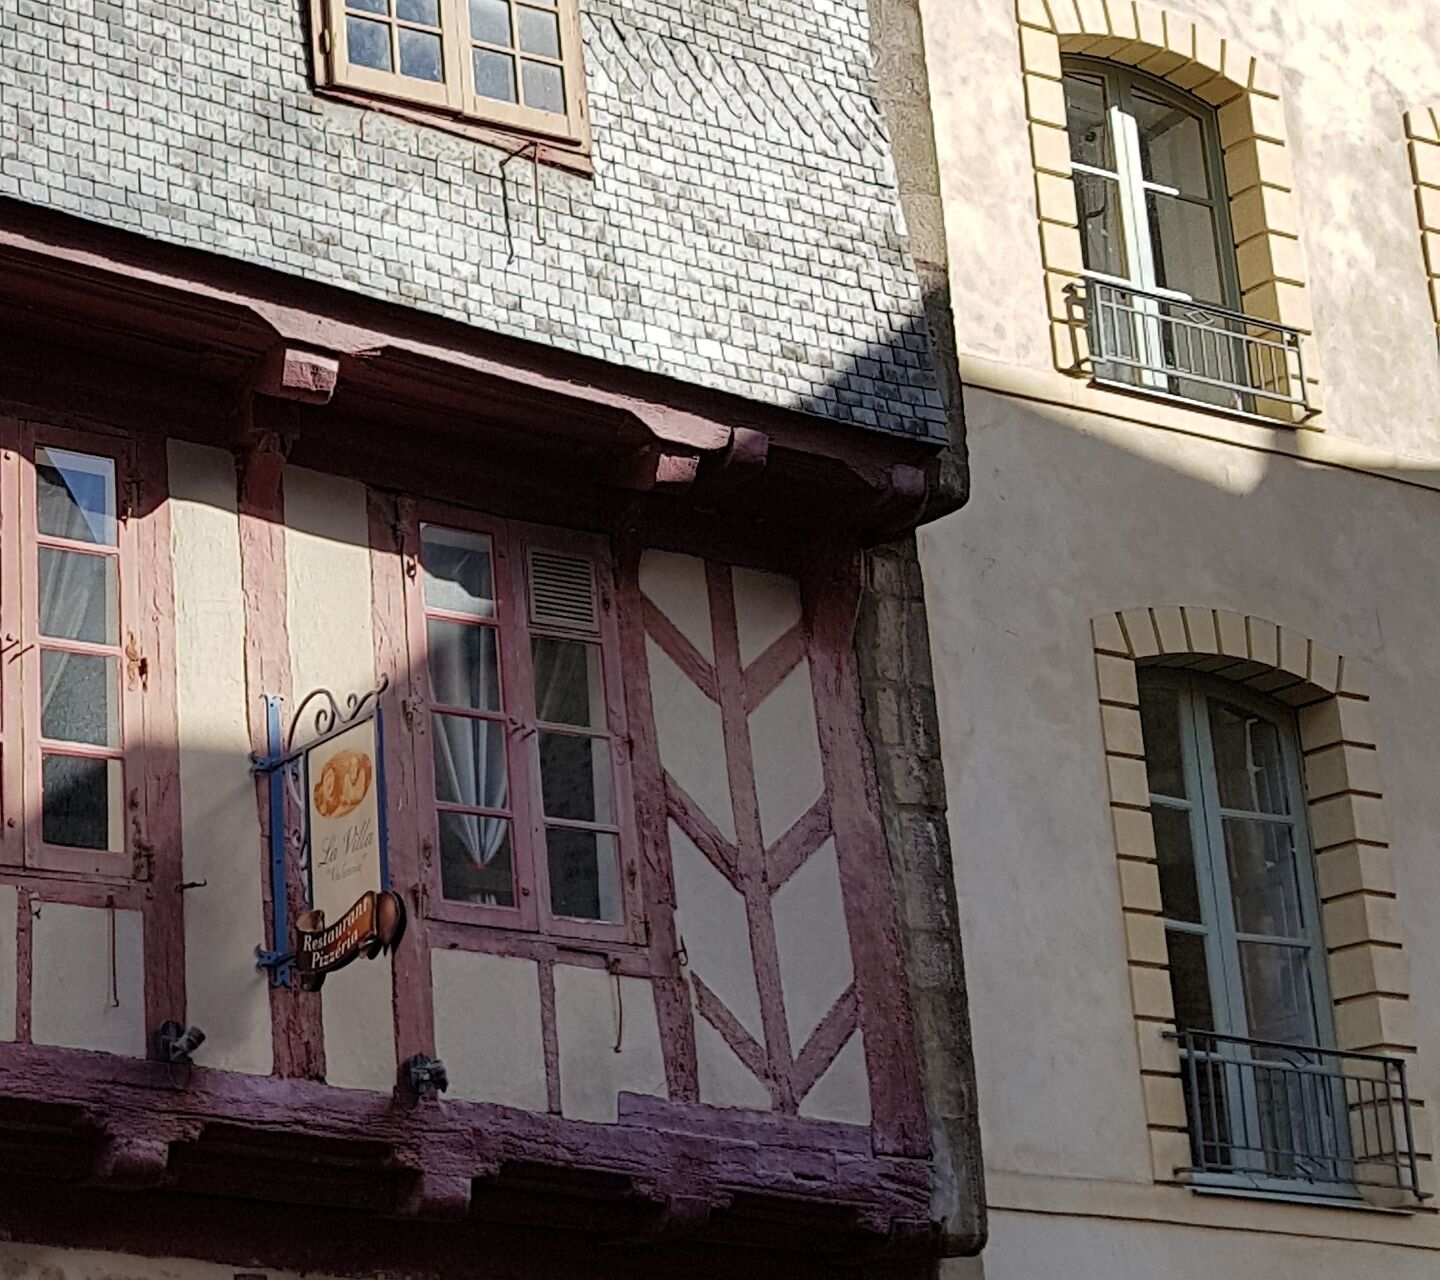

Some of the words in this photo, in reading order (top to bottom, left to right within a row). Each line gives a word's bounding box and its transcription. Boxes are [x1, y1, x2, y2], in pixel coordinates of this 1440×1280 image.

[344, 817, 374, 856] Villa
[302, 897, 369, 952] Restaurant
[310, 927, 358, 970] Pizzéria
